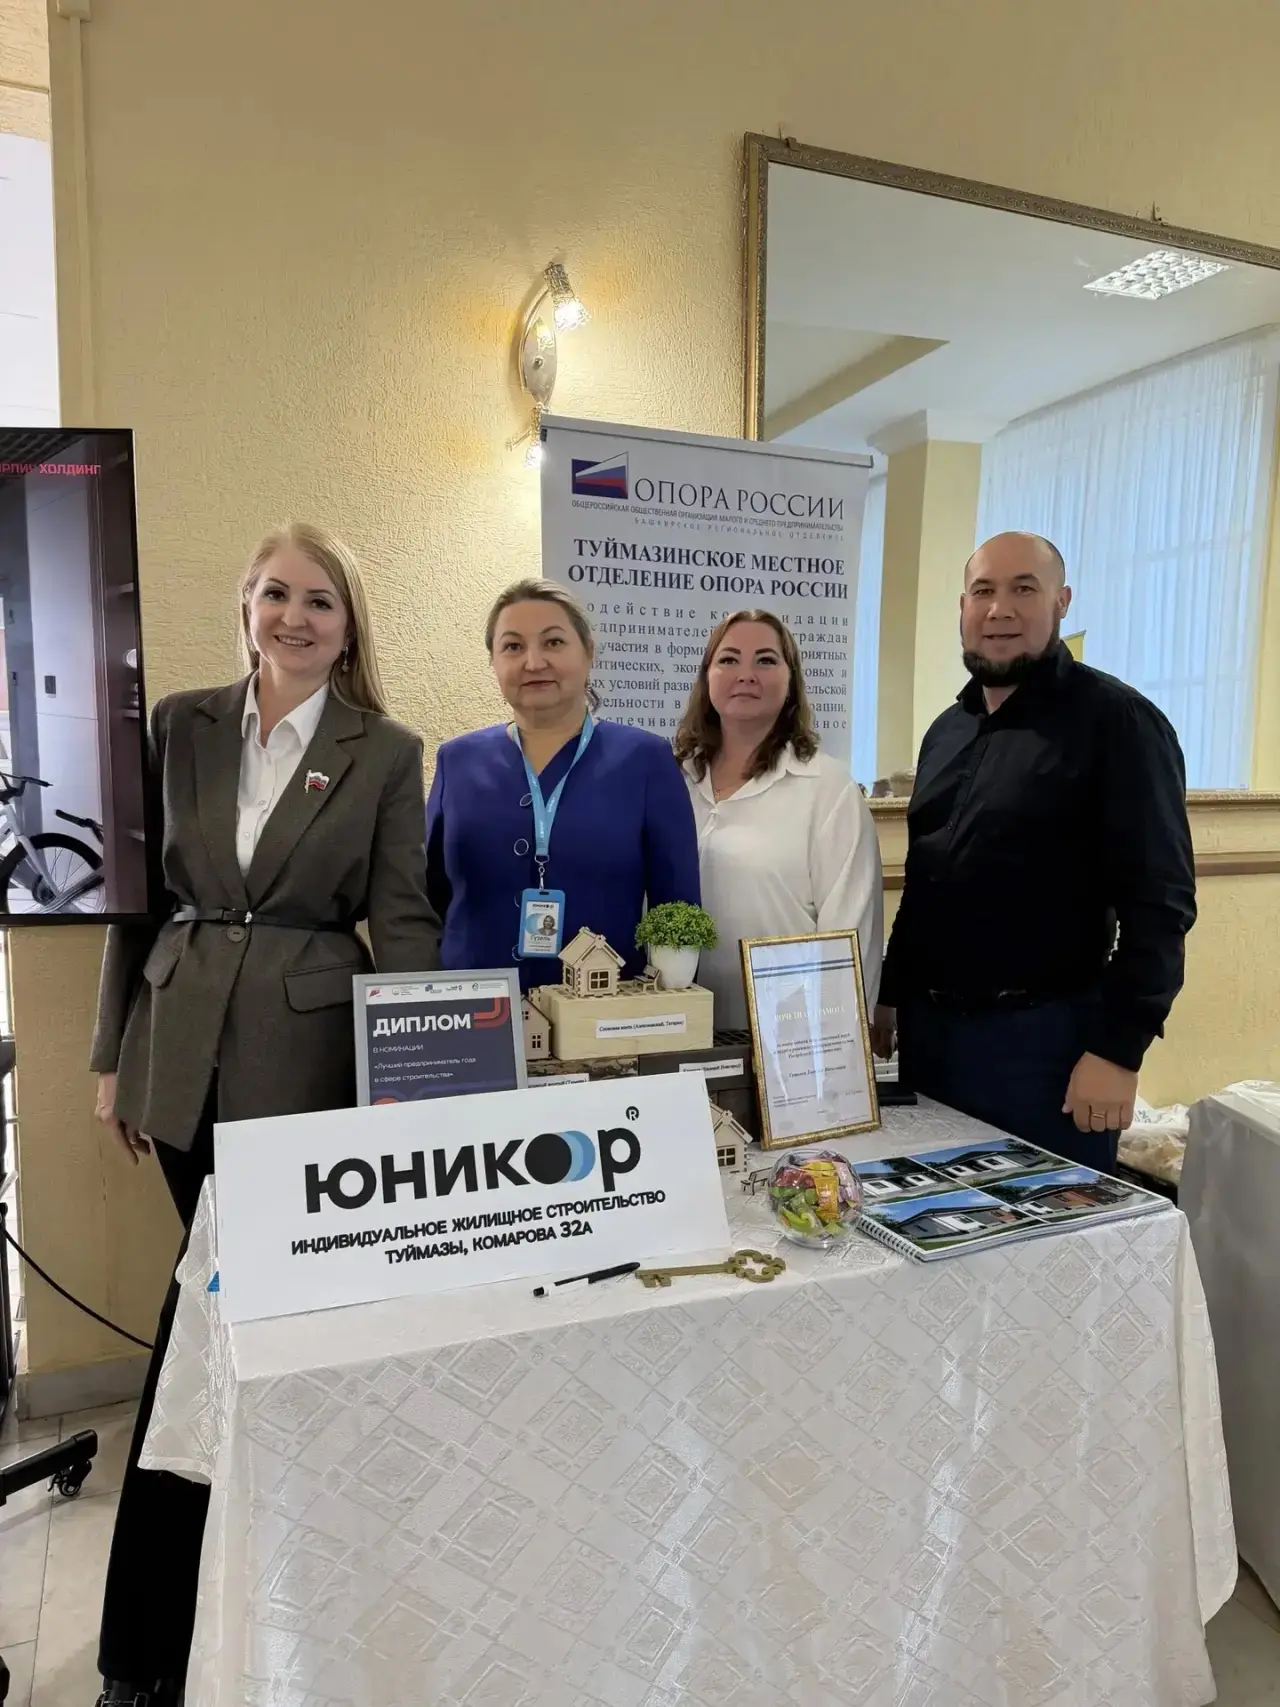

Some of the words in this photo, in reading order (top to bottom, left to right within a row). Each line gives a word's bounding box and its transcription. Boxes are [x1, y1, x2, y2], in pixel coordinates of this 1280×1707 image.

[39, 463, 101, 475] ХОЛДИНГ
[571, 499, 630, 514] ОБЩЕРОССИЙСКАЯ
[630, 506, 678, 518] ОБЩЕСТВЕННАЯ
[634, 478, 730, 511] ОПОРА
[737, 488, 844, 521] РОССИИ
[634, 517, 701, 531] БАШКИРСКОЕ
[708, 523, 782, 538] РЕГИОНАЛЬНОЕ
[574, 537, 746, 570] ТУЙМАЗИНСКОЕ
[751, 553, 845, 577] МЕСТНОЕ
[568, 564, 695, 592] ОТДЕЛЕНИЕ
[700, 574, 765, 596] ОПОРА
[771, 579, 849, 600] РОССИИ
[586, 602, 697, 619] одействие
[655, 646, 662, 654] в
[609, 678, 660, 692] условий
[674, 700, 681, 709] в
[373, 1013, 472, 1038] ДИПЛОМ
[379, 1043, 424, 1054] НОМИНАЦИИ
[404, 1058, 460, 1069] предприниматель
[462, 1057, 477, 1065] года
[380, 1075, 402, 1084] сфере
[292, 1219, 448, 1256] ИНДИВИДУАЛЬНОЕ
[451, 1206, 543, 1233] ЖИЛИЩНОЕ
[546, 1189, 666, 1219] СТРОИТЕЛЬСТВО
[384, 1239, 469, 1265] ТУЙМАЗЫ,
[472, 1226, 558, 1252] КОМАРОВА
[559, 1219, 594, 1239] 32А
